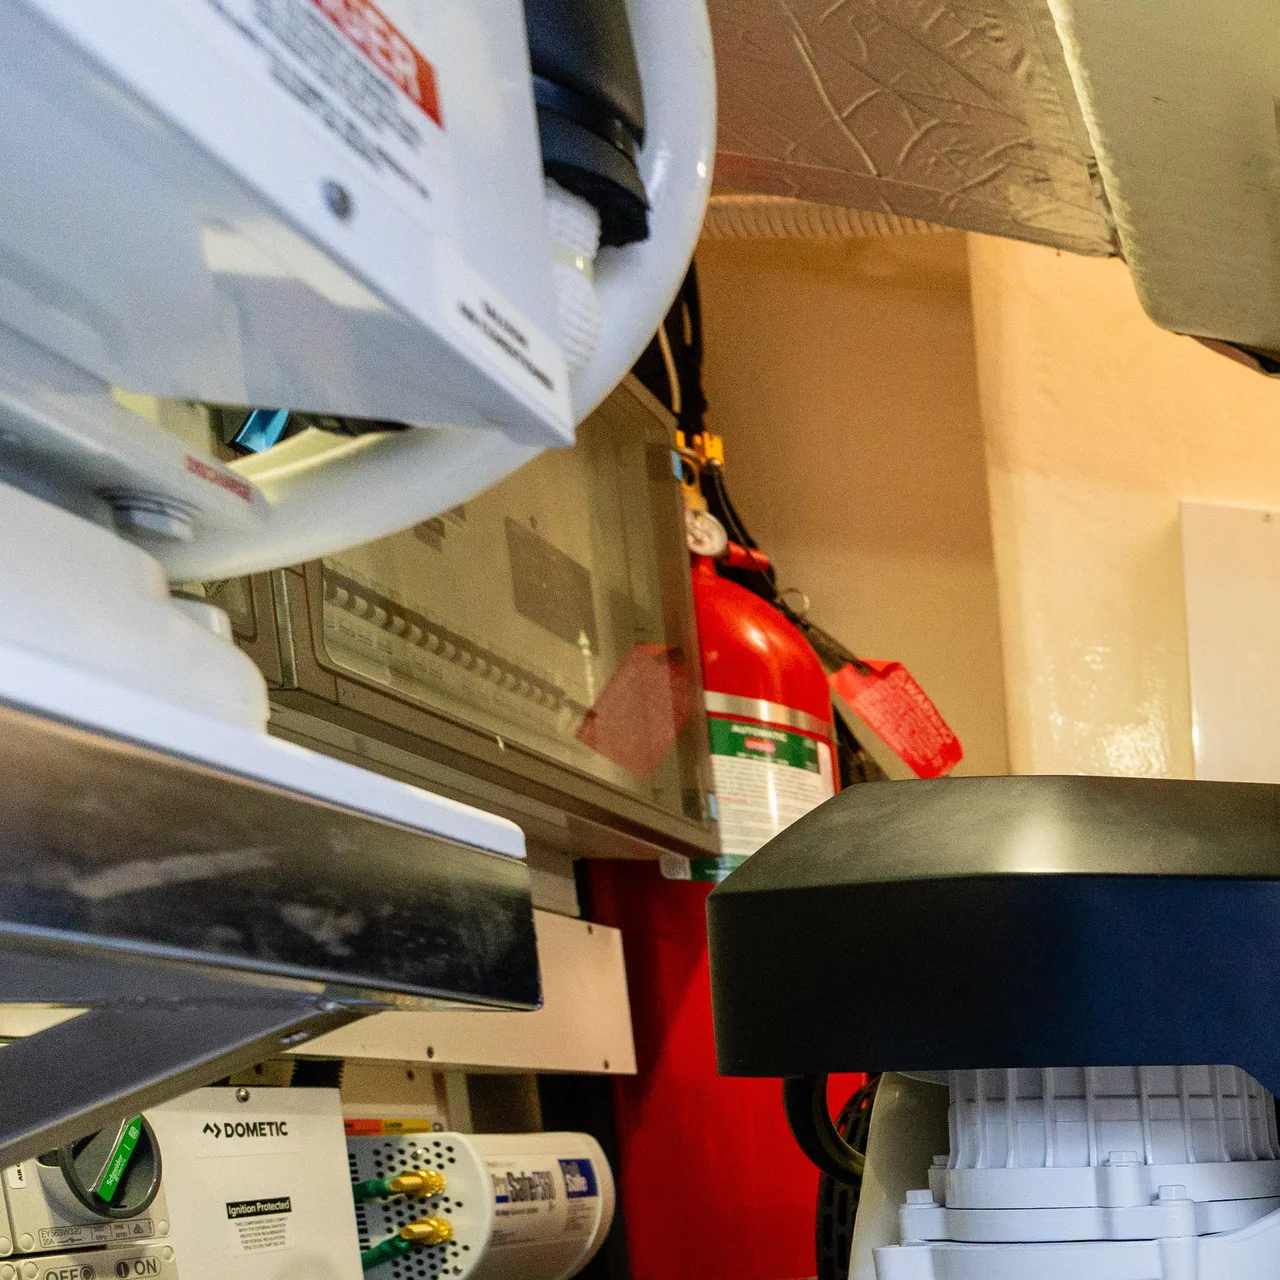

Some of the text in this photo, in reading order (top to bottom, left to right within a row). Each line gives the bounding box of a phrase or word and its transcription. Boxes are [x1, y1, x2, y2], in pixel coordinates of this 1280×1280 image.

[224, 1121, 289, 1138] DOMETIC
[106, 1155, 124, 1186] Schneider
[229, 1200, 290, 1217] Ignition Protected
[134, 1258, 157, 1276] ON
